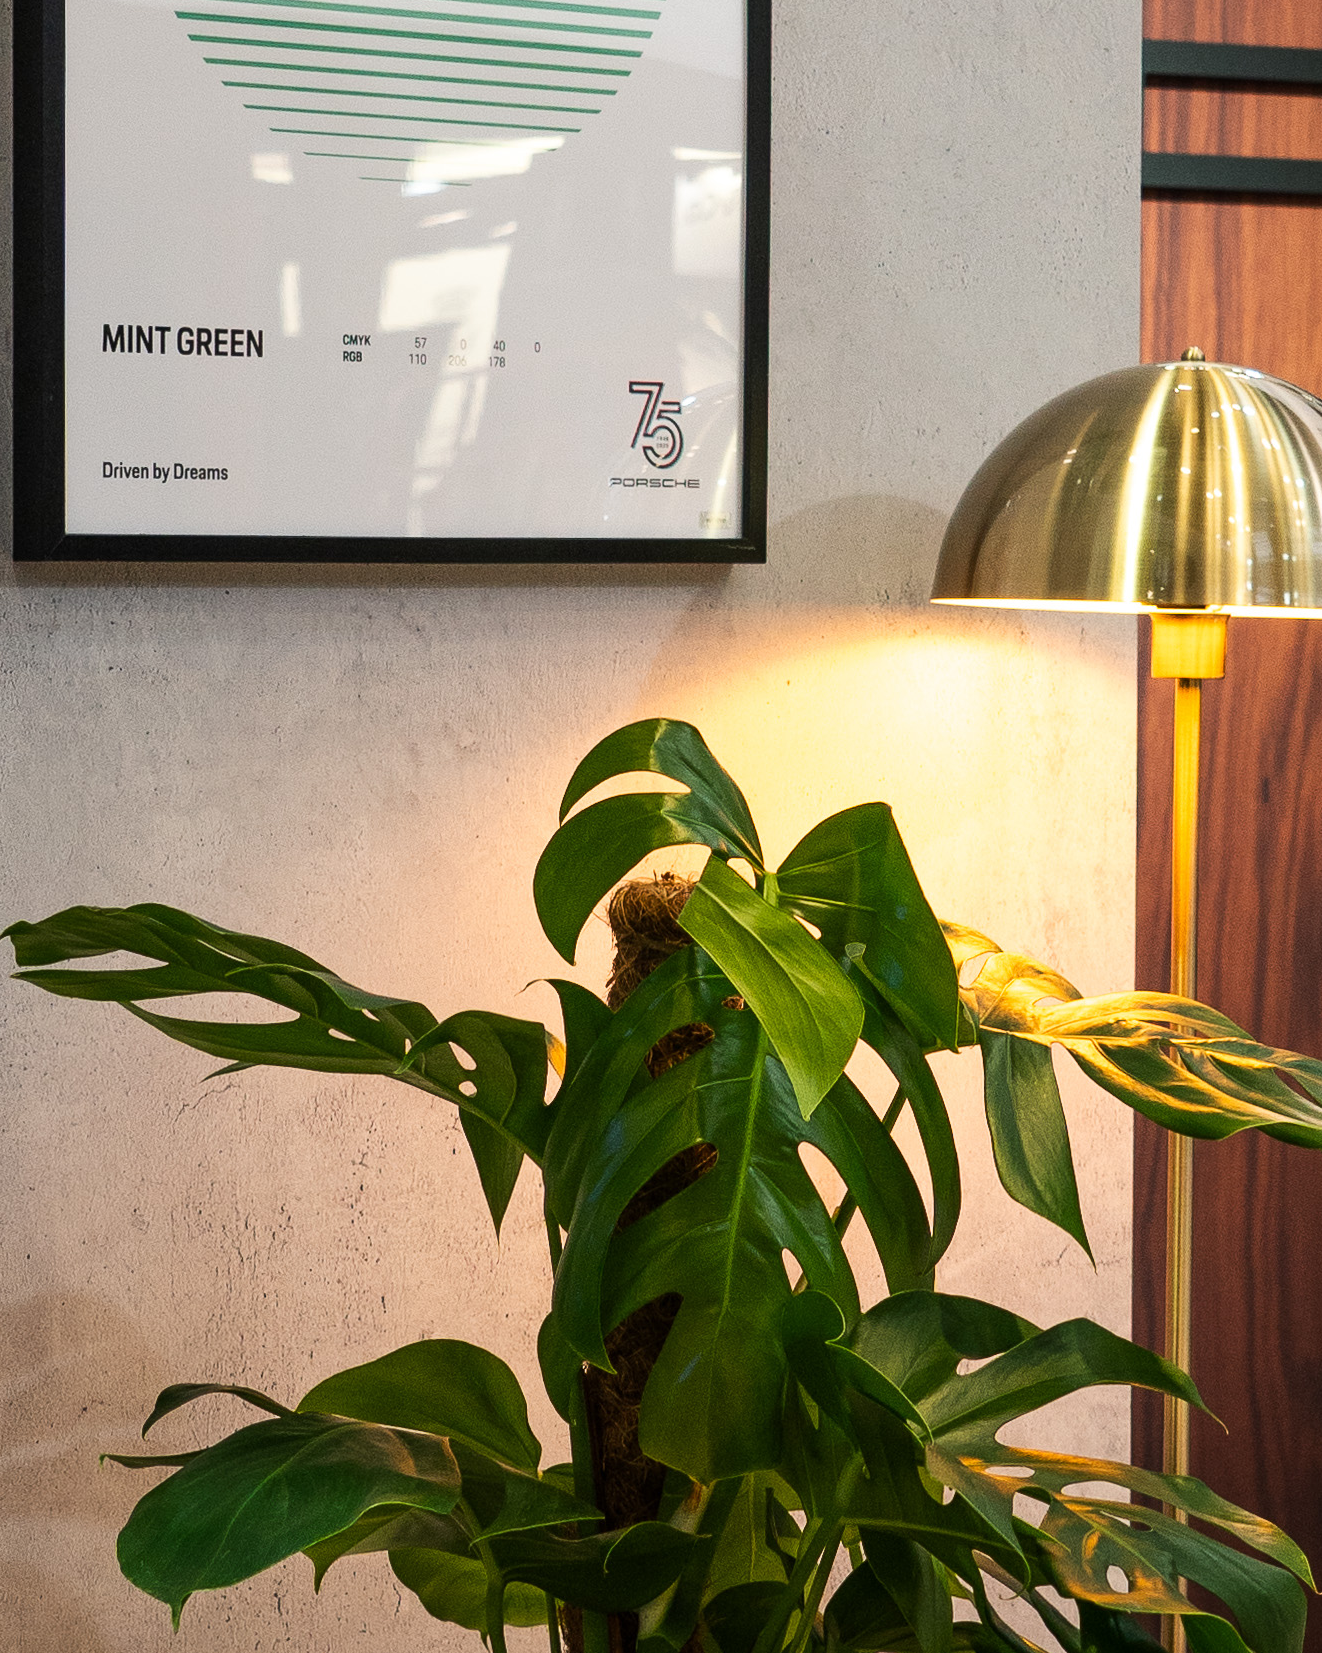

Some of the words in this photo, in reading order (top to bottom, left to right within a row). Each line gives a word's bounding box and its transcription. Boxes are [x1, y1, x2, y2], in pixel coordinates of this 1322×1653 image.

[102, 323, 171, 355] MINT
[176, 326, 264, 358] GREEN
[342, 334, 372, 346] CMYK
[414, 337, 427, 349] 57
[493, 340, 506, 352] 40
[533, 341, 541, 353] 0
[342, 351, 363, 362] RGB
[409, 353, 427, 365] 110
[448, 355, 467, 367] 206
[489, 356, 506, 368] 178
[628, 380, 684, 469] 75
[102, 461, 149, 479] Driven
[152, 462, 170, 484] by
[173, 463, 229, 480] Dreams
[609, 477, 701, 489] PORSCHE
